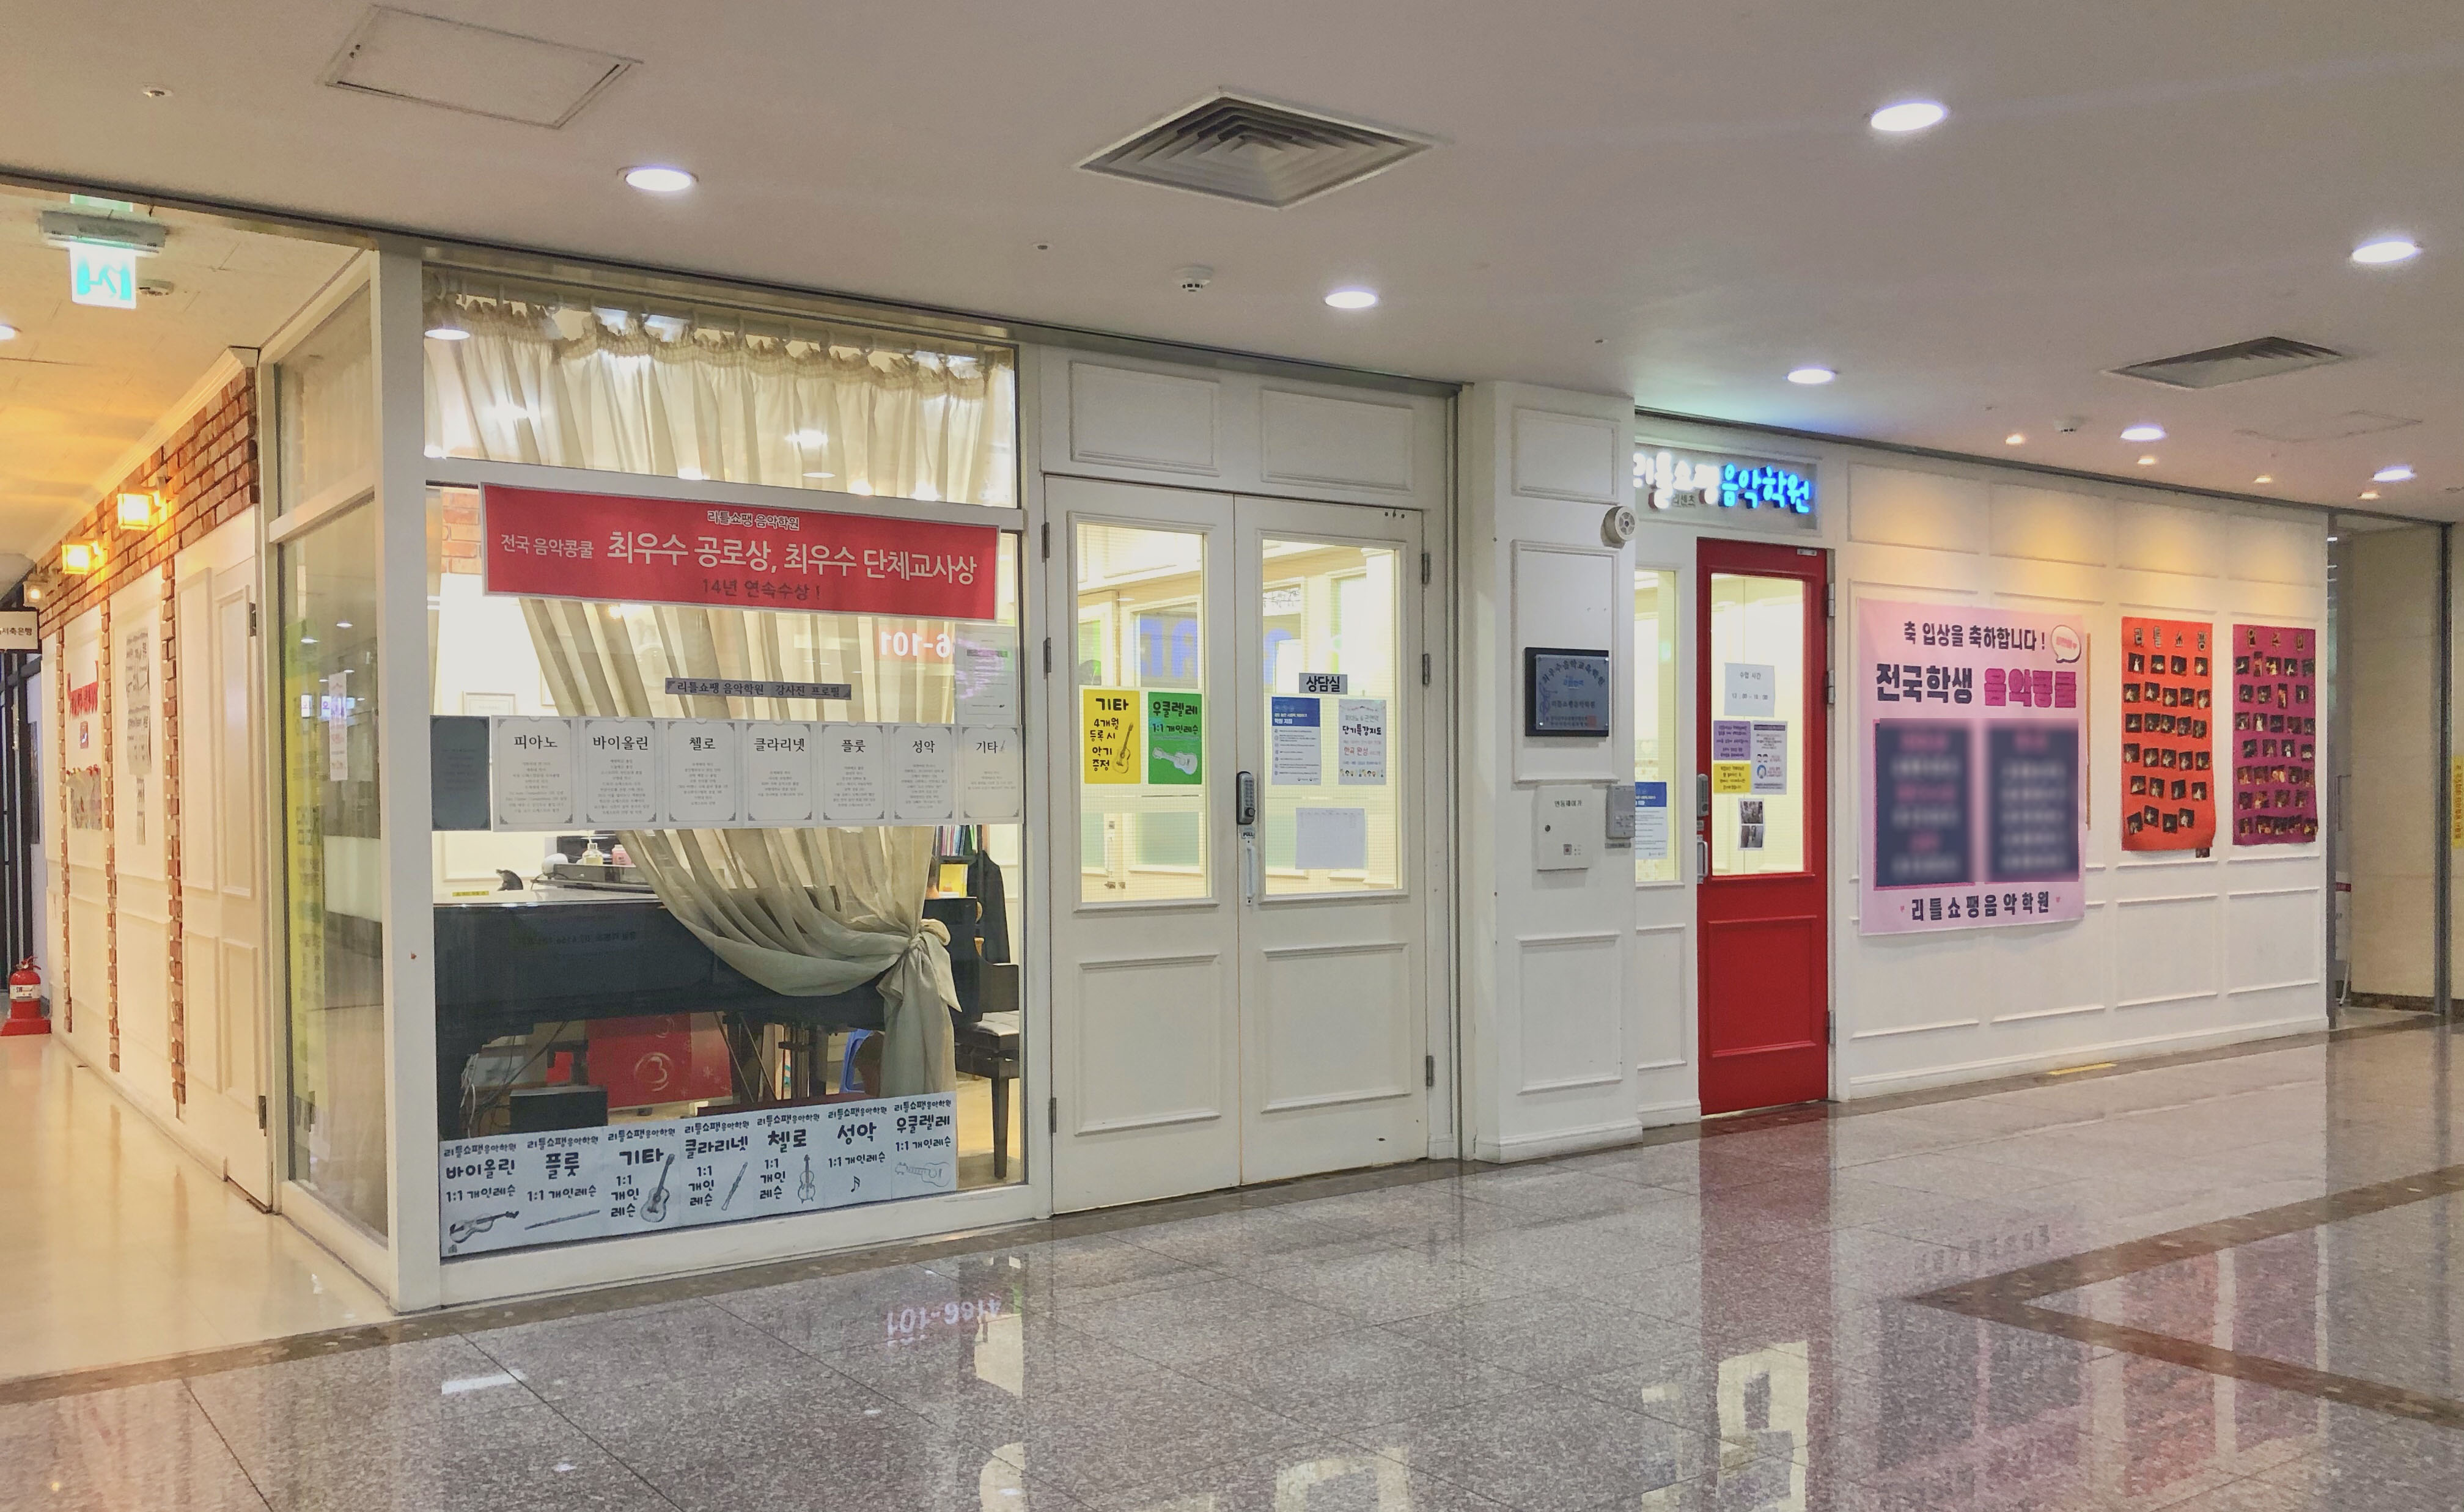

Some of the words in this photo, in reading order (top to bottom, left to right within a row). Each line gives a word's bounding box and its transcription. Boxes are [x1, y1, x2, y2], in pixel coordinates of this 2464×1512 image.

[708, 510, 752, 527] 리틀쇼팽
[756, 516, 800, 530] 음악학원
[501, 534, 530, 554] 전국
[533, 538, 594, 559] 음악콩쿨
[607, 532, 688, 565] 최우수
[694, 537, 776, 573] 공로상,
[784, 544, 856, 576] 최우수
[864, 549, 976, 585] 단체교사상
[703, 579, 737, 597] 14년
[745, 582, 809, 601] 연속수상
[1904, 621, 1916, 645] 축
[1922, 623, 1963, 647] 입상을
[677, 681, 719, 694] 리틀쇼팽
[723, 683, 763, 695] 음악학원
[775, 684, 806, 697] 강사진
[811, 685, 841, 698] 프로필
[1306, 676, 1340, 692] 상담실
[1877, 663, 1972, 704] 전국학생
[1095, 698, 1128, 711] 기타
[1153, 701, 1198, 717] 우쿨렐레
[1094, 717, 1119, 730] 4개월
[1152, 724, 1164, 733] 1:1
[1166, 724, 1198, 735] 개인레슨
[513, 734, 558, 750] 피아노
[592, 735, 649, 751] 바이올린
[1090, 730, 1104, 742] 등록
[689, 737, 716, 751] 첼로
[754, 738, 805, 752] 클라리넷
[841, 739, 866, 754] 플룻
[912, 739, 935, 754] 성악
[976, 740, 999, 754] 기타
[1092, 746, 1112, 756] 악기
[1092, 760, 1109, 771] 증정
[896, 1114, 950, 1132] 우쿨렐레
[768, 1129, 807, 1153] 첼로
[837, 1122, 877, 1145] 성악
[685, 1136, 749, 1159] 클라리넷
[895, 1141, 910, 1151] 1:1
[913, 1136, 951, 1150] 개인레슨
[619, 1148, 664, 1165] 기타
[764, 1159, 779, 1169] 1:1
[828, 1158, 842, 1168] 1:1
[845, 1152, 886, 1165] 개인레슨
[446, 1159, 515, 1179] 바이올린
[545, 1152, 580, 1180] 플룻
[697, 1166, 712, 1176] 1:1
[616, 1175, 632, 1186] 1:1
[760, 1172, 786, 1184] 개인
[446, 1191, 463, 1202] 1:1
[467, 1184, 515, 1200] 개인레슨
[528, 1190, 544, 1202] 1:1
[548, 1184, 597, 1199] 개인레슨
[688, 1180, 715, 1192] 개인
[611, 1188, 639, 1201] 개인
[690, 1195, 713, 1206] 레슨
[760, 1188, 782, 1200] 레슨
[611, 1203, 636, 1217] 레슨
